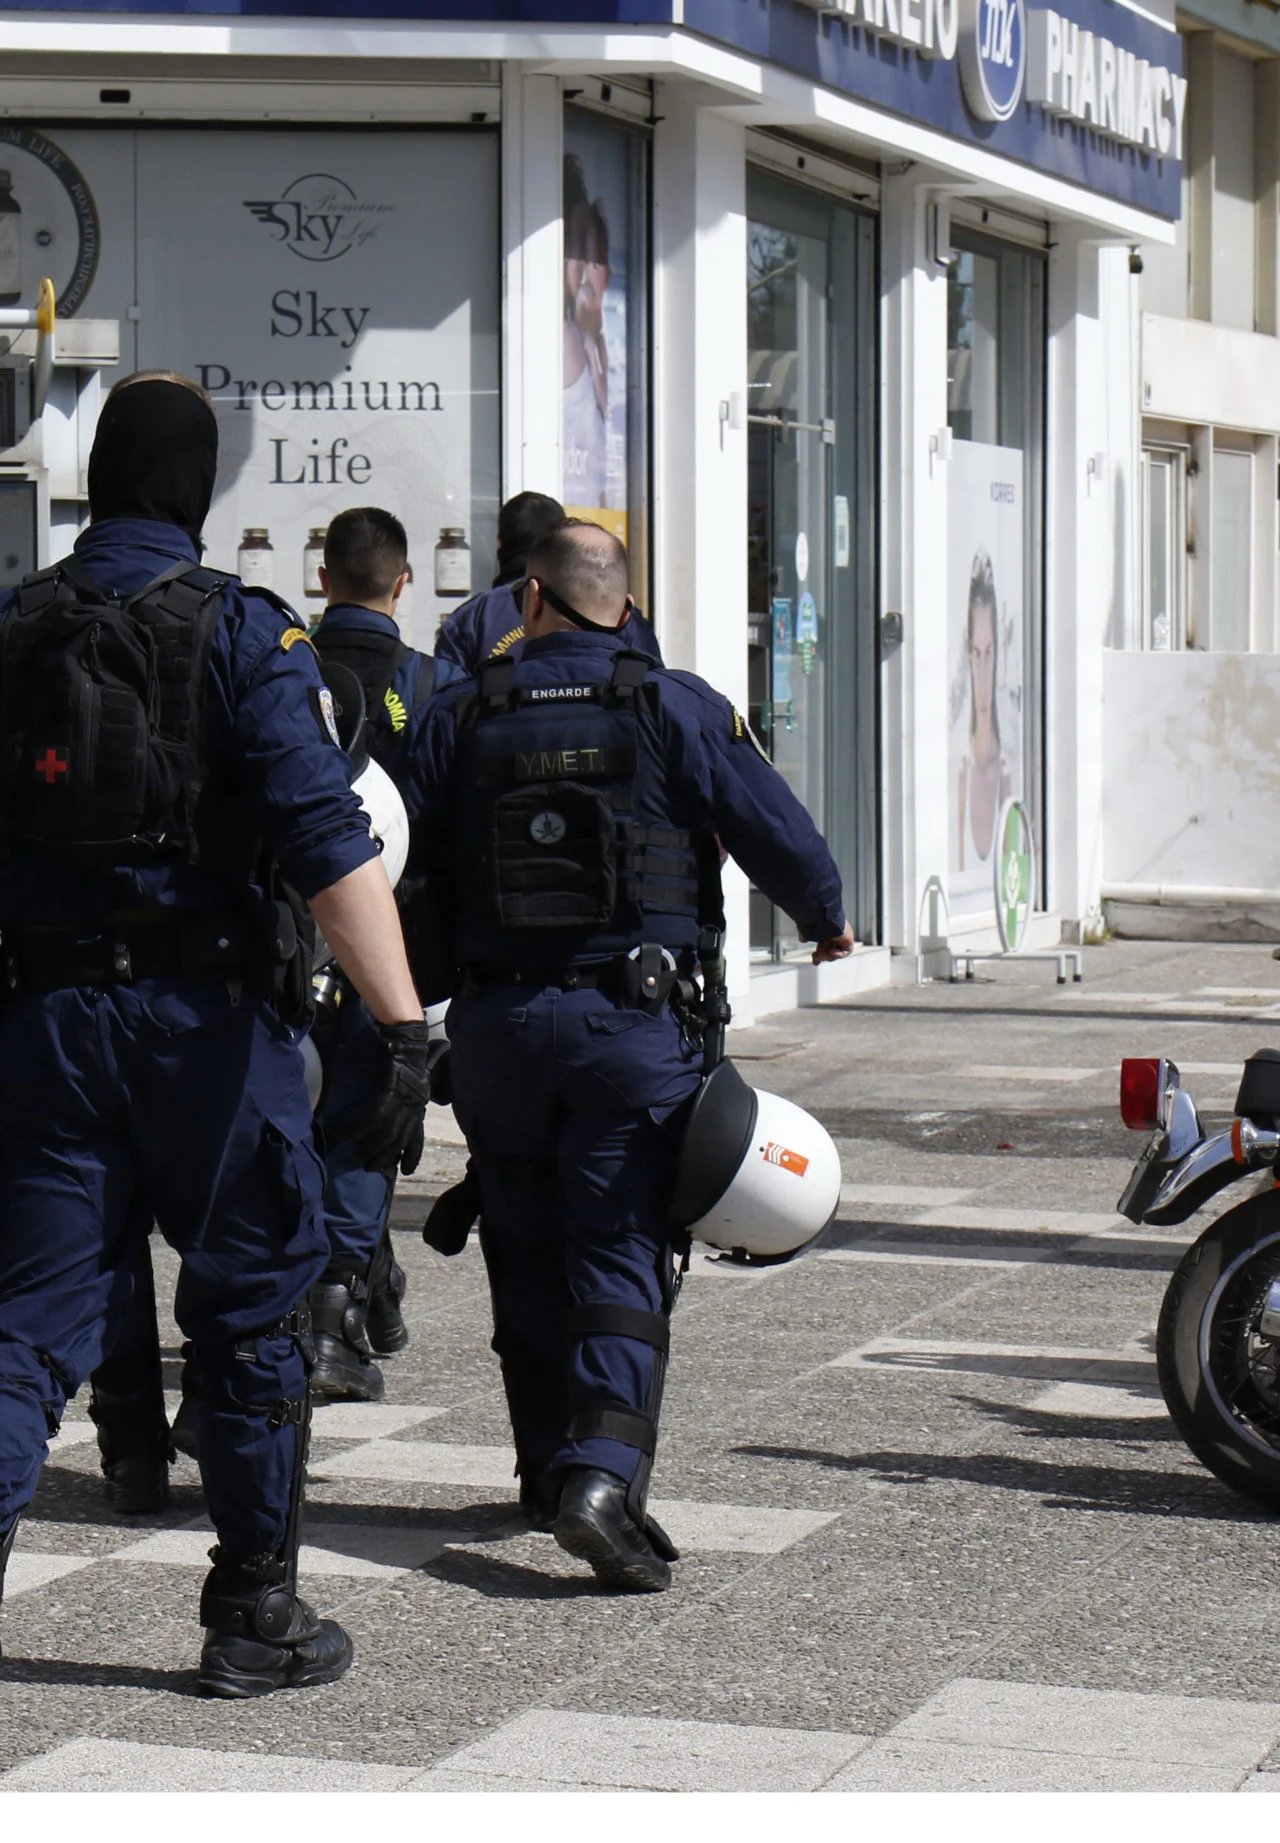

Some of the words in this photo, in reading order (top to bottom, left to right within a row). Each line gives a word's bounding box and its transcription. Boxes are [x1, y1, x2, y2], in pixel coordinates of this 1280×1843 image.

[1047, 9, 1188, 160] PHARMACY
[30, 136, 64, 169] LIFE
[242, 200, 344, 254] Sky
[271, 289, 371, 349] Sky
[195, 364, 444, 411] Premium
[269, 438, 372, 485] Life
[532, 687, 591, 699] ENGARDE
